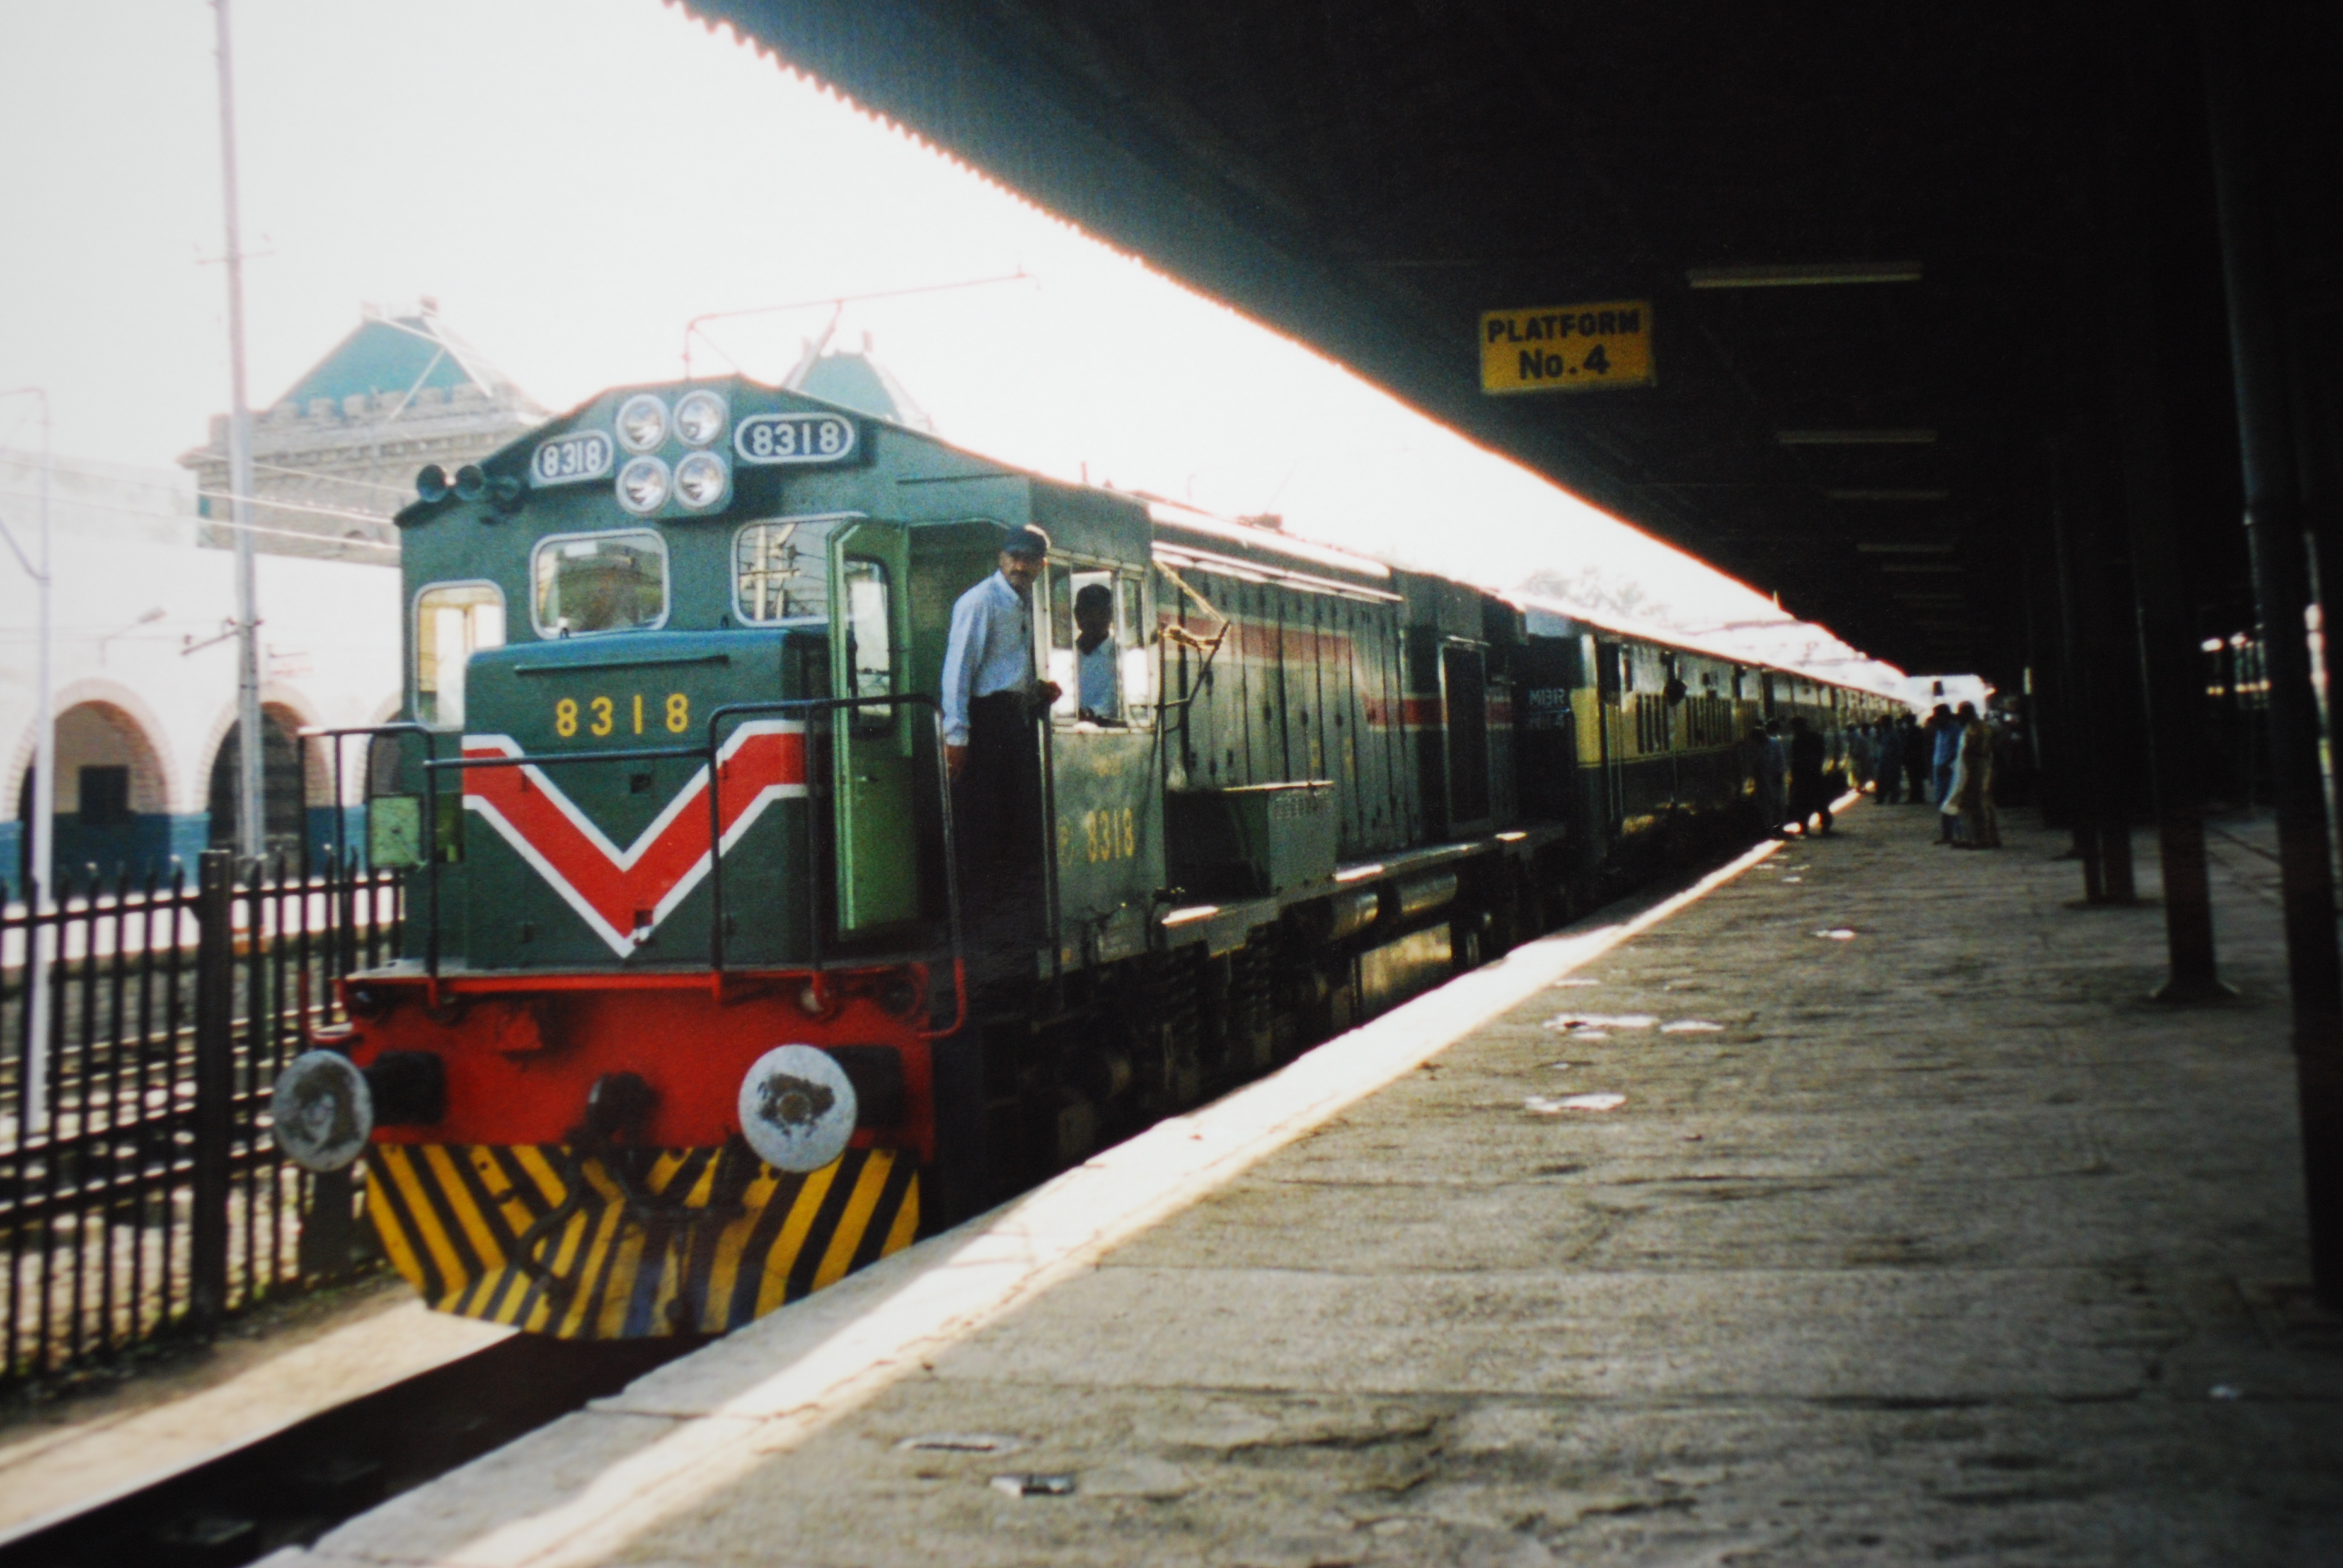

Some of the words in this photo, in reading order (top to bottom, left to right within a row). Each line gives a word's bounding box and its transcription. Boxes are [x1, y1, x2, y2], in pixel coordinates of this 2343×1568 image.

[1488, 309, 1639, 343] PLATFORM
[753, 422, 841, 456] 8318
[544, 439, 603, 477] 8318
[556, 693, 688, 737] 8318
